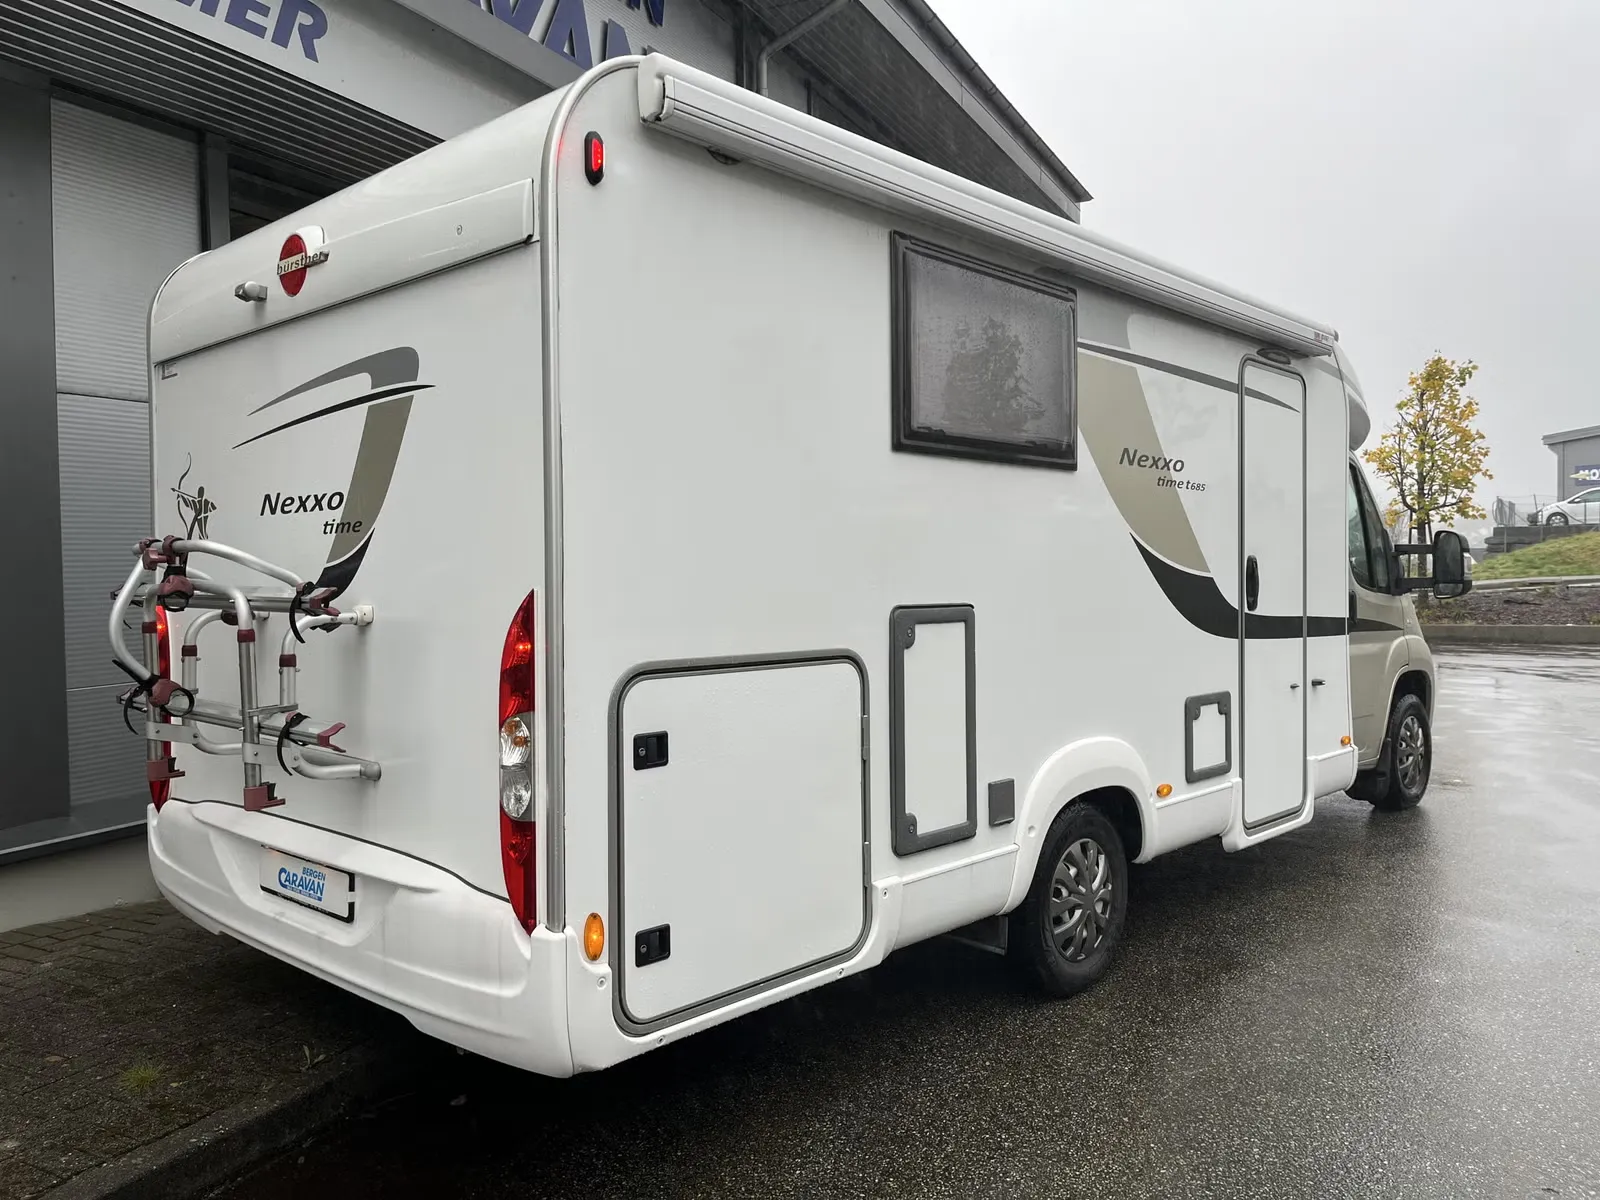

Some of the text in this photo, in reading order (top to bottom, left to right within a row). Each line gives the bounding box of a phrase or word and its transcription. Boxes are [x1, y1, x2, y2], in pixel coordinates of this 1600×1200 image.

[1119, 447, 1185, 473] Nexxo
[1157, 476, 1184, 489] time
[260, 492, 344, 516] Nexxo
[322, 519, 363, 535] time
[278, 867, 325, 897] CARAVAN
[302, 866, 326, 882] BERGEN
